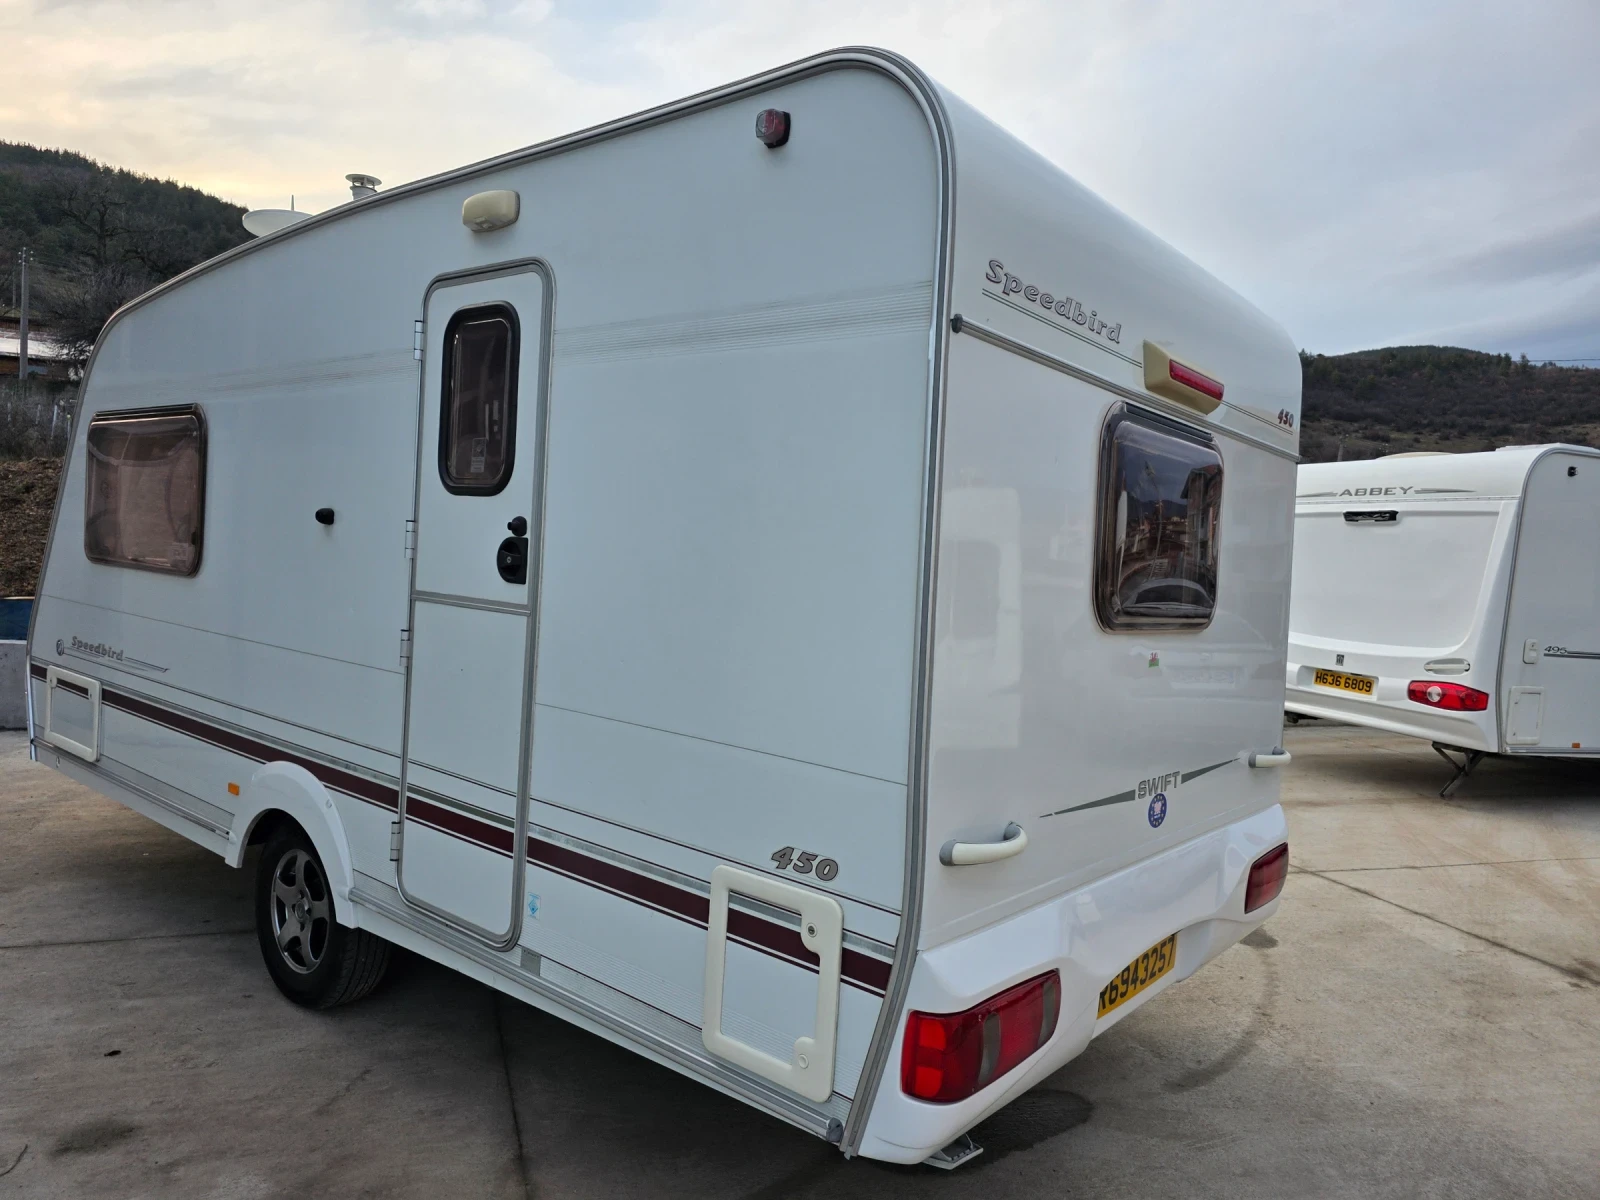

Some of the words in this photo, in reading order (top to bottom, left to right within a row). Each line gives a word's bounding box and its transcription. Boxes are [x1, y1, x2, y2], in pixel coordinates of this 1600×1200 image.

[985, 259, 1122, 344] Speedbird
[1277, 408, 1294, 428] 450
[1339, 486, 1414, 497] ABBEY
[71, 635, 124, 662] Speedbird
[1315, 671, 1342, 687] H636
[1344, 677, 1372, 692] 6809
[1138, 771, 1180, 800] SWIFT
[771, 846, 839, 882] 450
